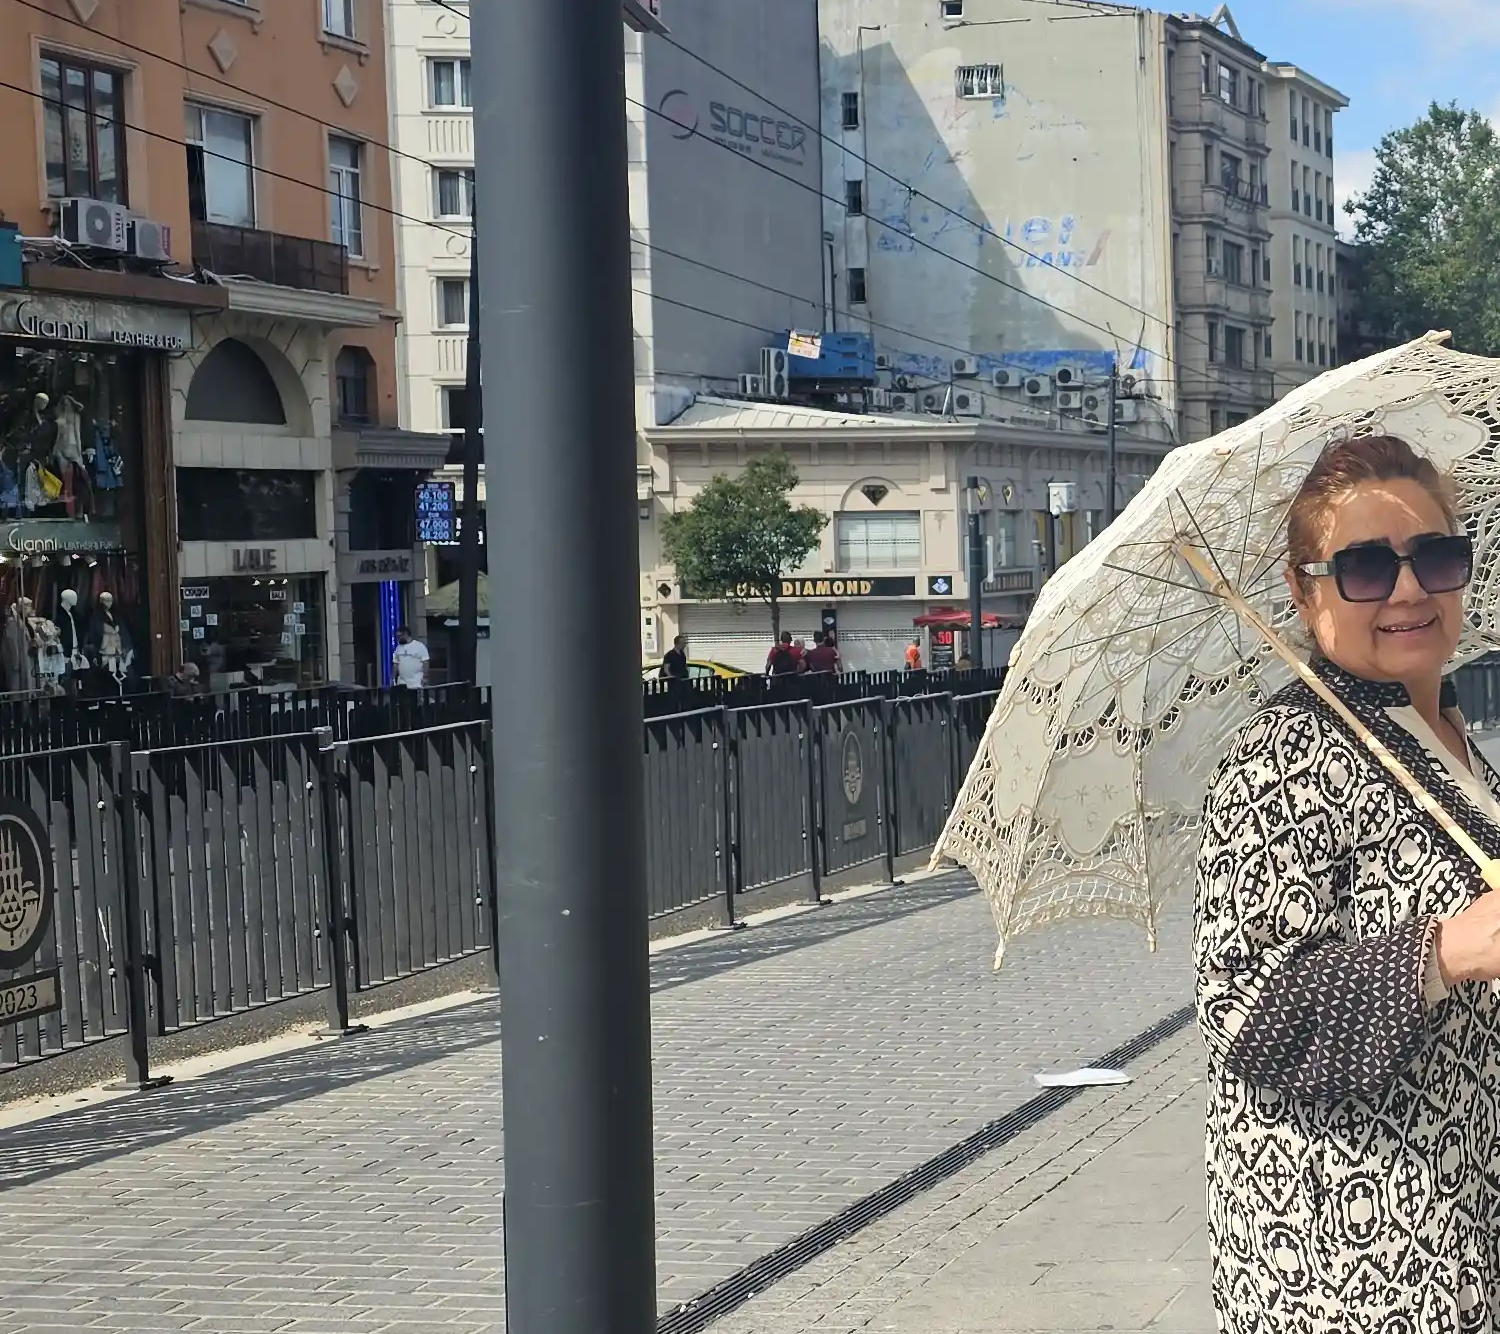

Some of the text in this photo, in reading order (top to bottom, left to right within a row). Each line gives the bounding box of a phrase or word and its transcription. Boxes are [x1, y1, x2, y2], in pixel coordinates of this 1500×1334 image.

[709, 101, 806, 155] SOCCER
[16, 298, 184, 349] Gianni LEATHER & FUR
[418, 501, 449, 511] 41.200
[781, 580, 872, 596] DIAMOND
